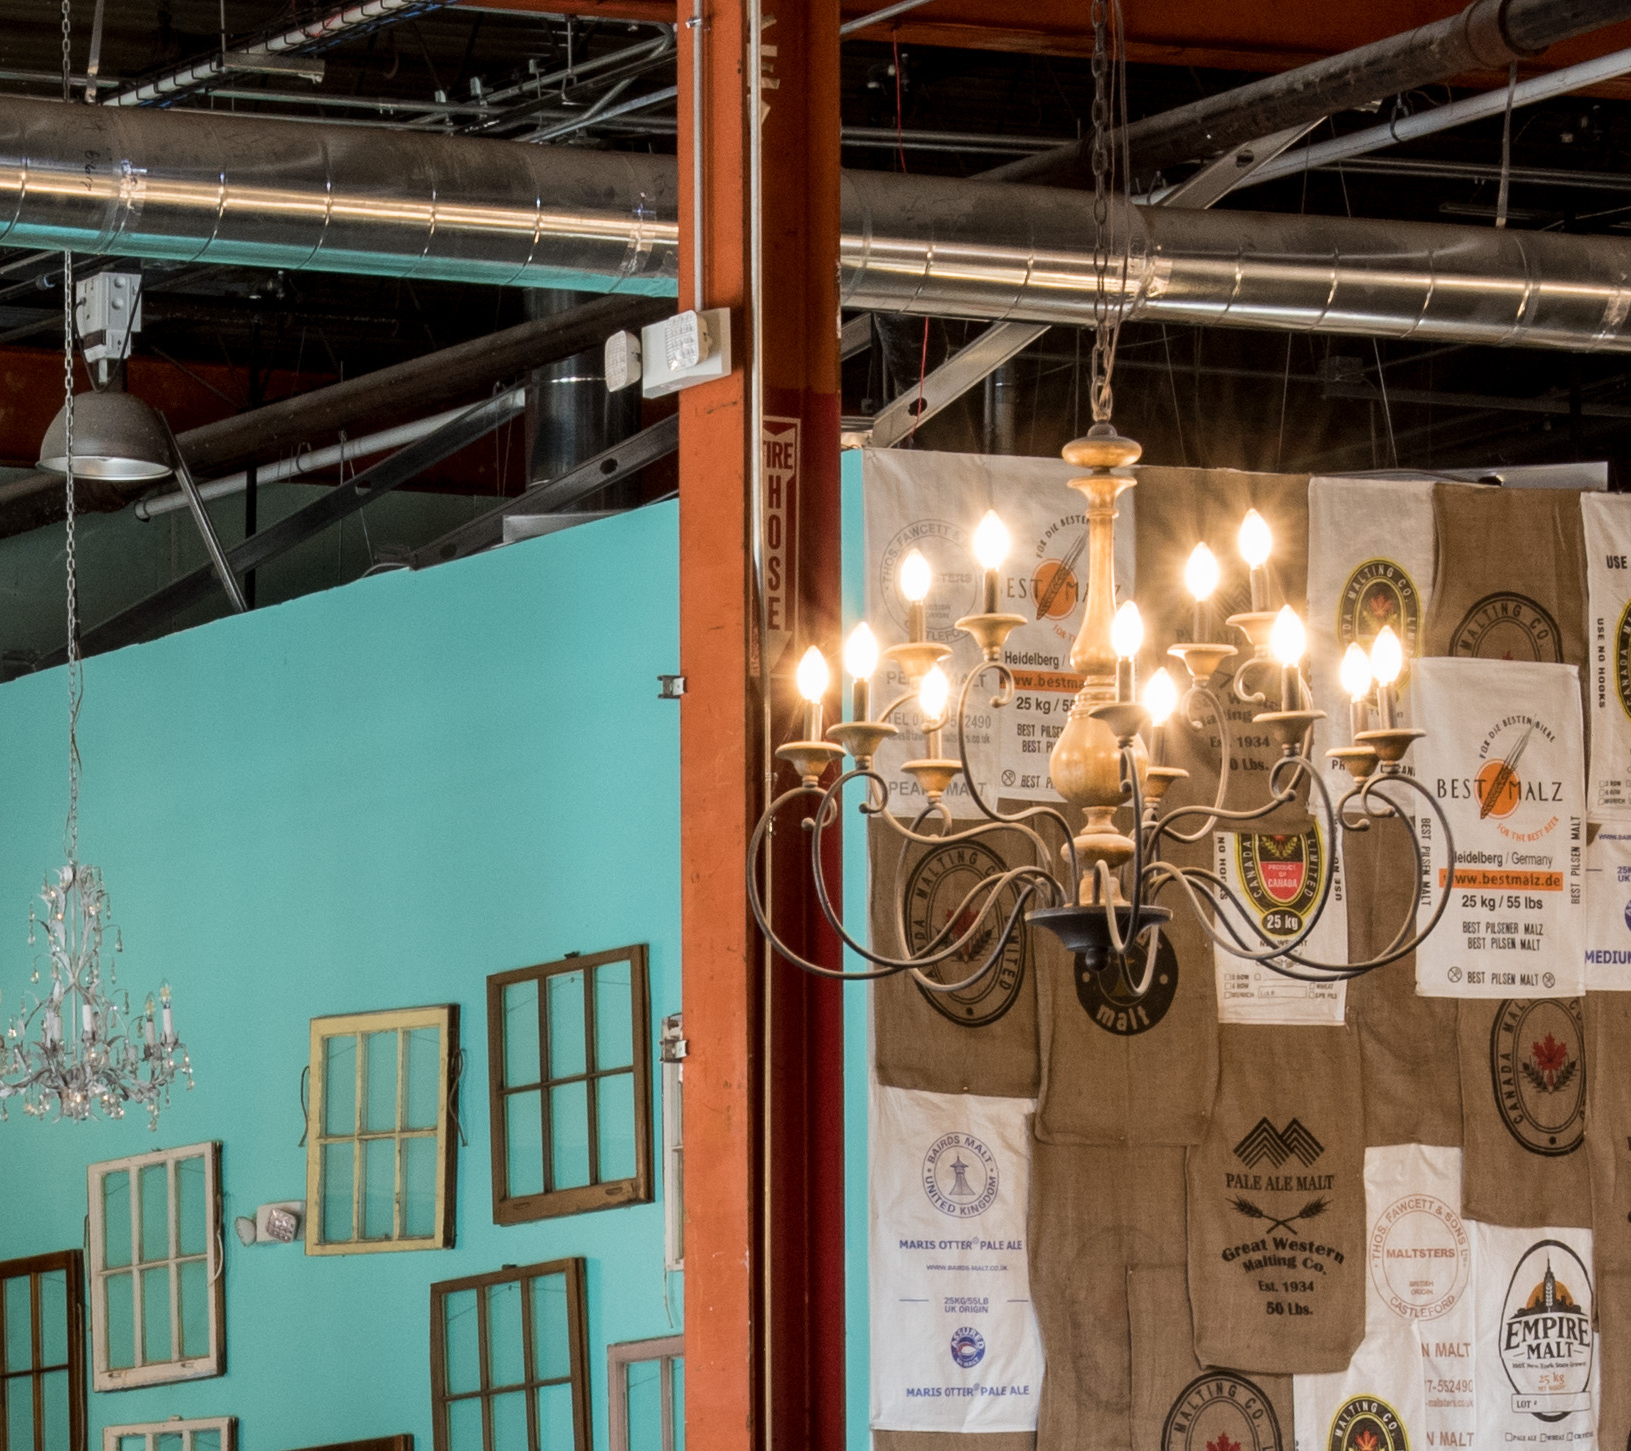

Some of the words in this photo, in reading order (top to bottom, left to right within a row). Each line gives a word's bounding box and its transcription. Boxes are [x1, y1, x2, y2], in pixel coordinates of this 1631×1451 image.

[763, 440, 793, 469] IRE
[768, 475, 781, 631] HOSE
[1606, 555, 1627, 570] USE
[1437, 778, 1487, 799] BEST
[1508, 781, 1562, 801] MALZ
[1512, 852, 1553, 868] Germany
[1462, 896, 1477, 908] 25
[1480, 896, 1495, 911] kg
[1507, 896, 1521, 908] 55
[1525, 896, 1543, 909] lbs
[1463, 921, 1481, 934] BEST
[1485, 921, 1519, 935] PILSENER
[1524, 922, 1543, 936] MALZ
[1467, 937, 1487, 950] BEST
[1492, 937, 1516, 950] PILSEN
[1520, 938, 1540, 951] MALT
[1467, 971, 1486, 984] BEST
[1490, 972, 1515, 986] PILSEN
[1520, 973, 1540, 986] MALT
[927, 1134, 961, 1163] BAIRDS
[964, 1135, 992, 1164] MALT
[1225, 1173, 1261, 1191] PALE
[1265, 1174, 1293, 1191] ALE
[1296, 1173, 1334, 1191] MALT
[924, 1175, 958, 1213] UNITED
[959, 1174, 997, 1217] KINGDOM
[899, 1240, 936, 1249] MARIS
[980, 1241, 1004, 1250] PALE
[1006, 1241, 1022, 1250] ALE
[1221, 1238, 1268, 1264] Great
[1272, 1238, 1345, 1264] Western
[1386, 1248, 1455, 1259] MALTSTERS
[1242, 1254, 1298, 1274] Malting
[1302, 1257, 1327, 1275] Co.
[1258, 1280, 1278, 1293] Est.
[1282, 1279, 1315, 1293] 1934
[1266, 1302, 1285, 1315] 50
[1288, 1302, 1313, 1315] Lbs.
[1389, 1294, 1457, 1320] CASTLEFORD
[1505, 1314, 1591, 1352] EMPIRE
[1526, 1343, 1574, 1360] MALT
